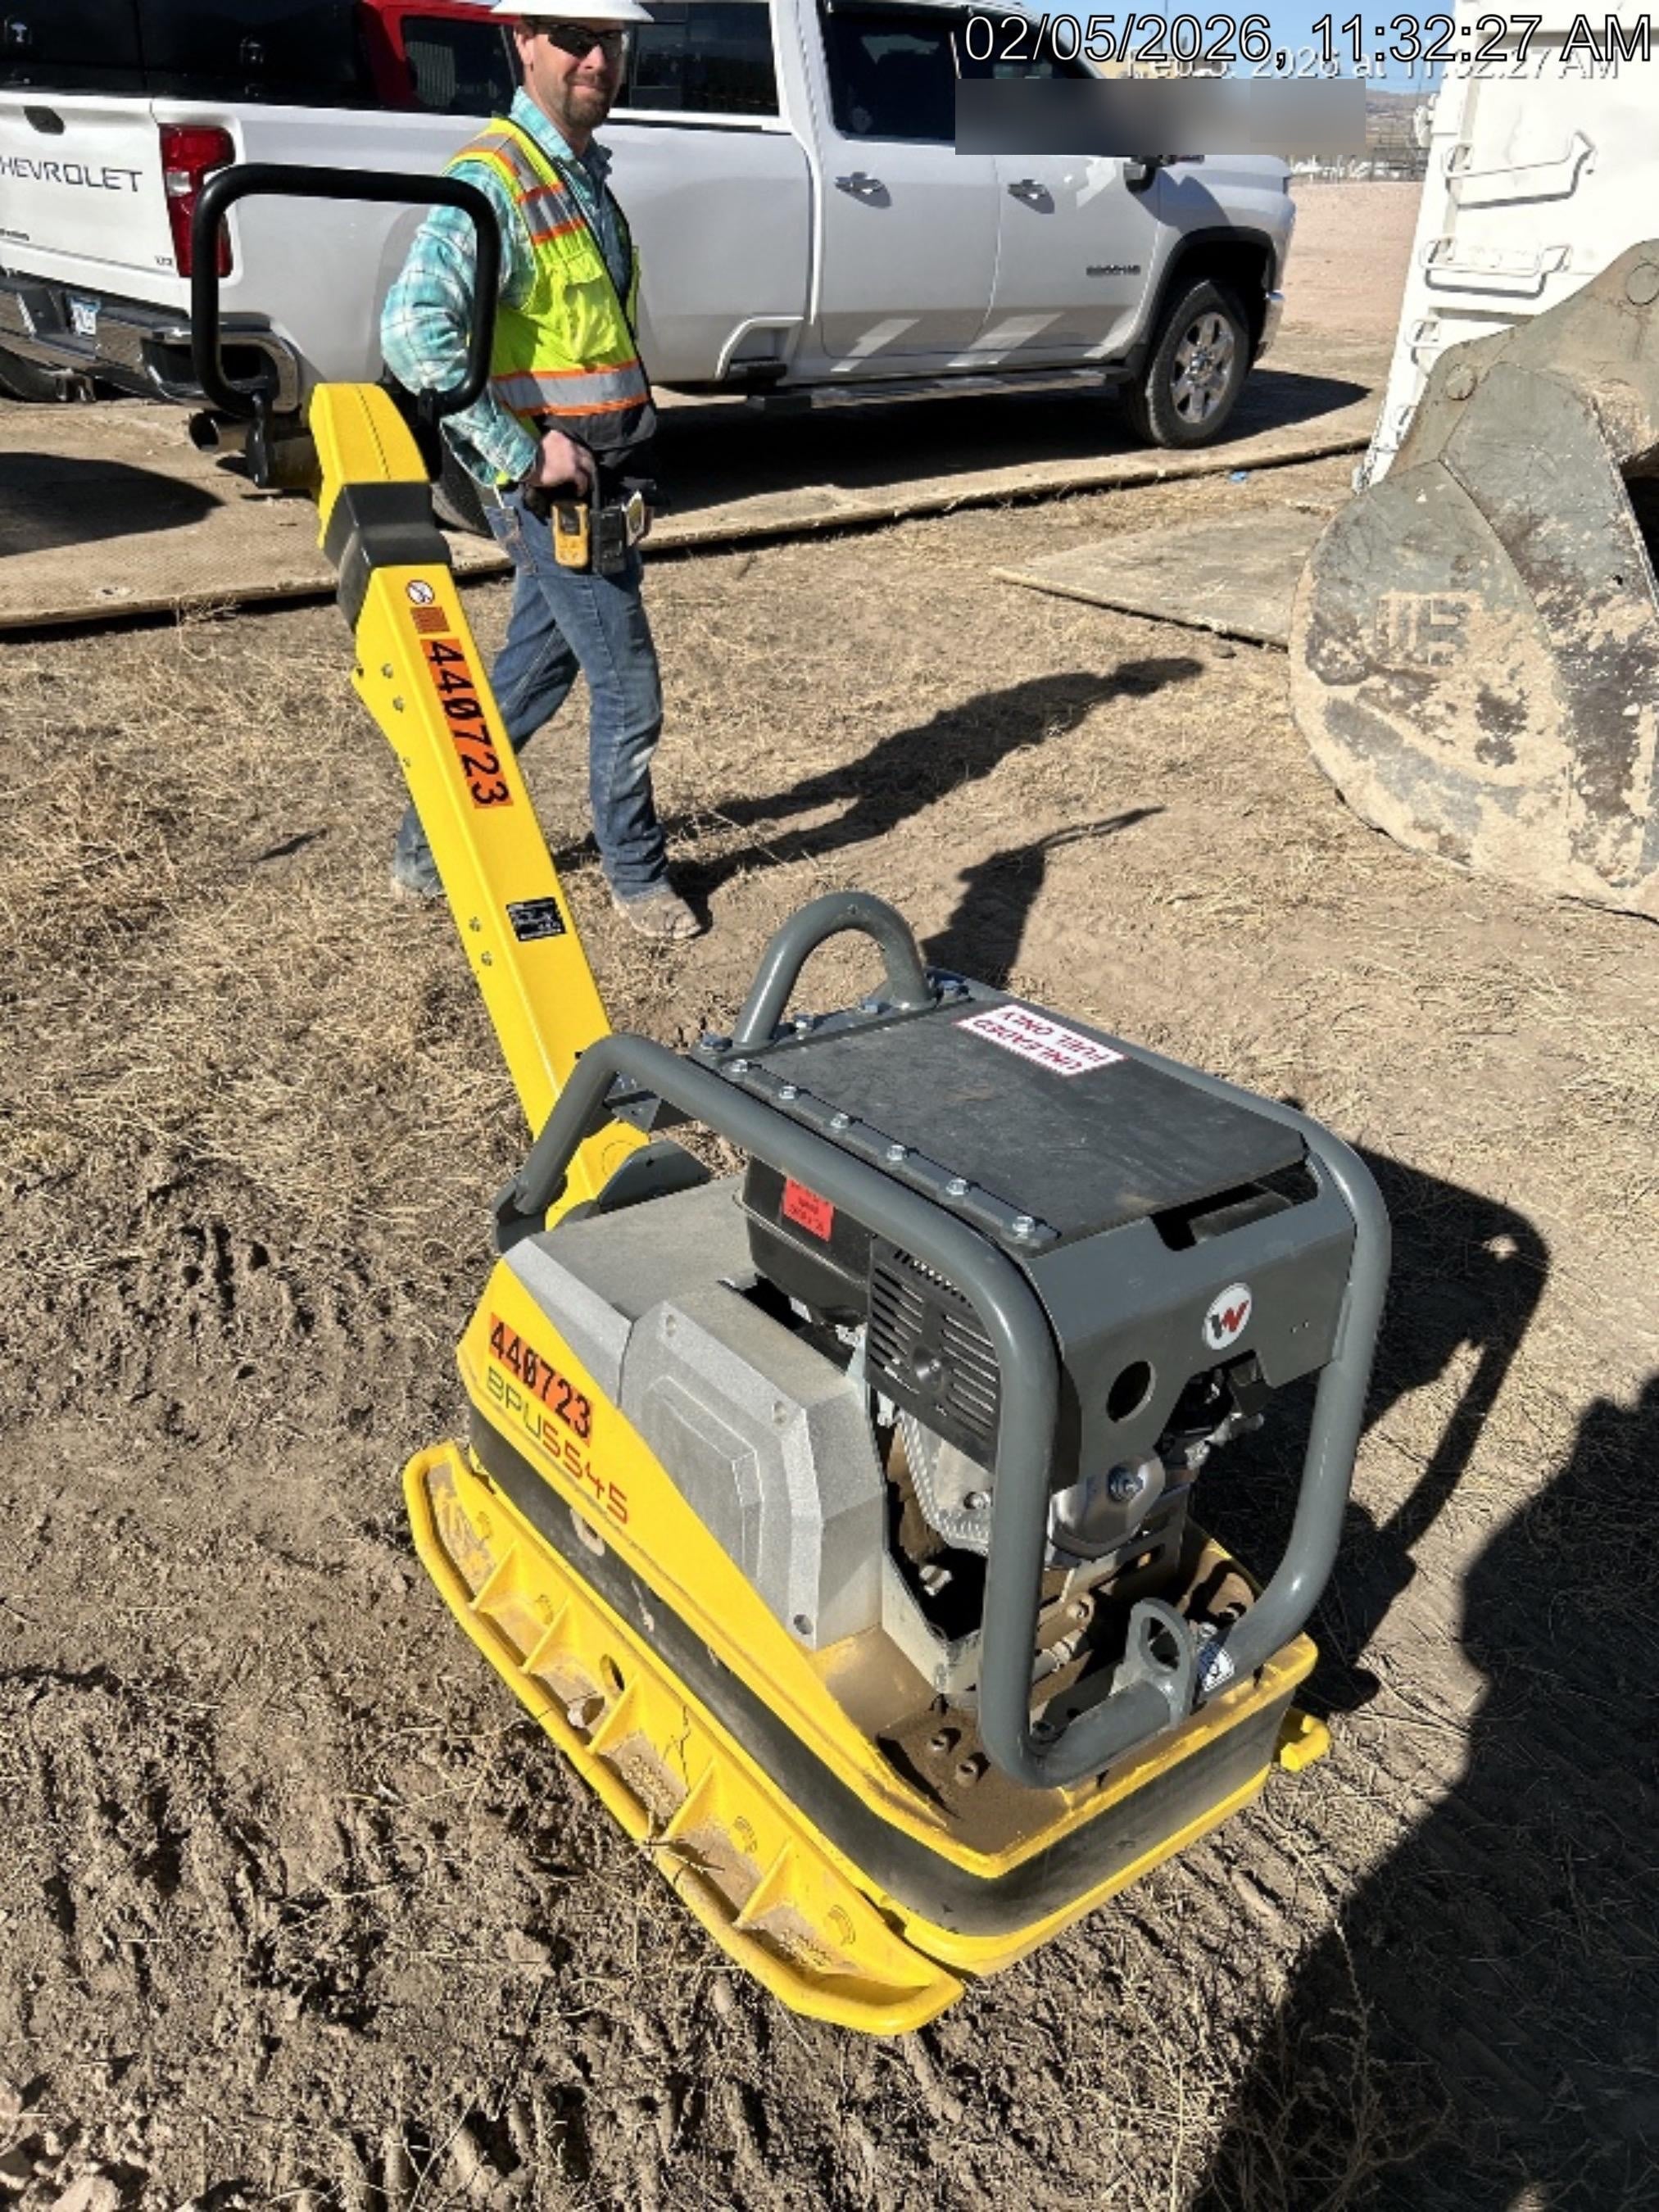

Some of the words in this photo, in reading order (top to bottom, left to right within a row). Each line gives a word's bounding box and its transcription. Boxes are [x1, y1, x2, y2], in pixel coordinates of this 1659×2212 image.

[0, 156, 143, 193] HEVROLET
[428, 640, 510, 806] 440723
[492, 1321, 592, 1439] 440723
